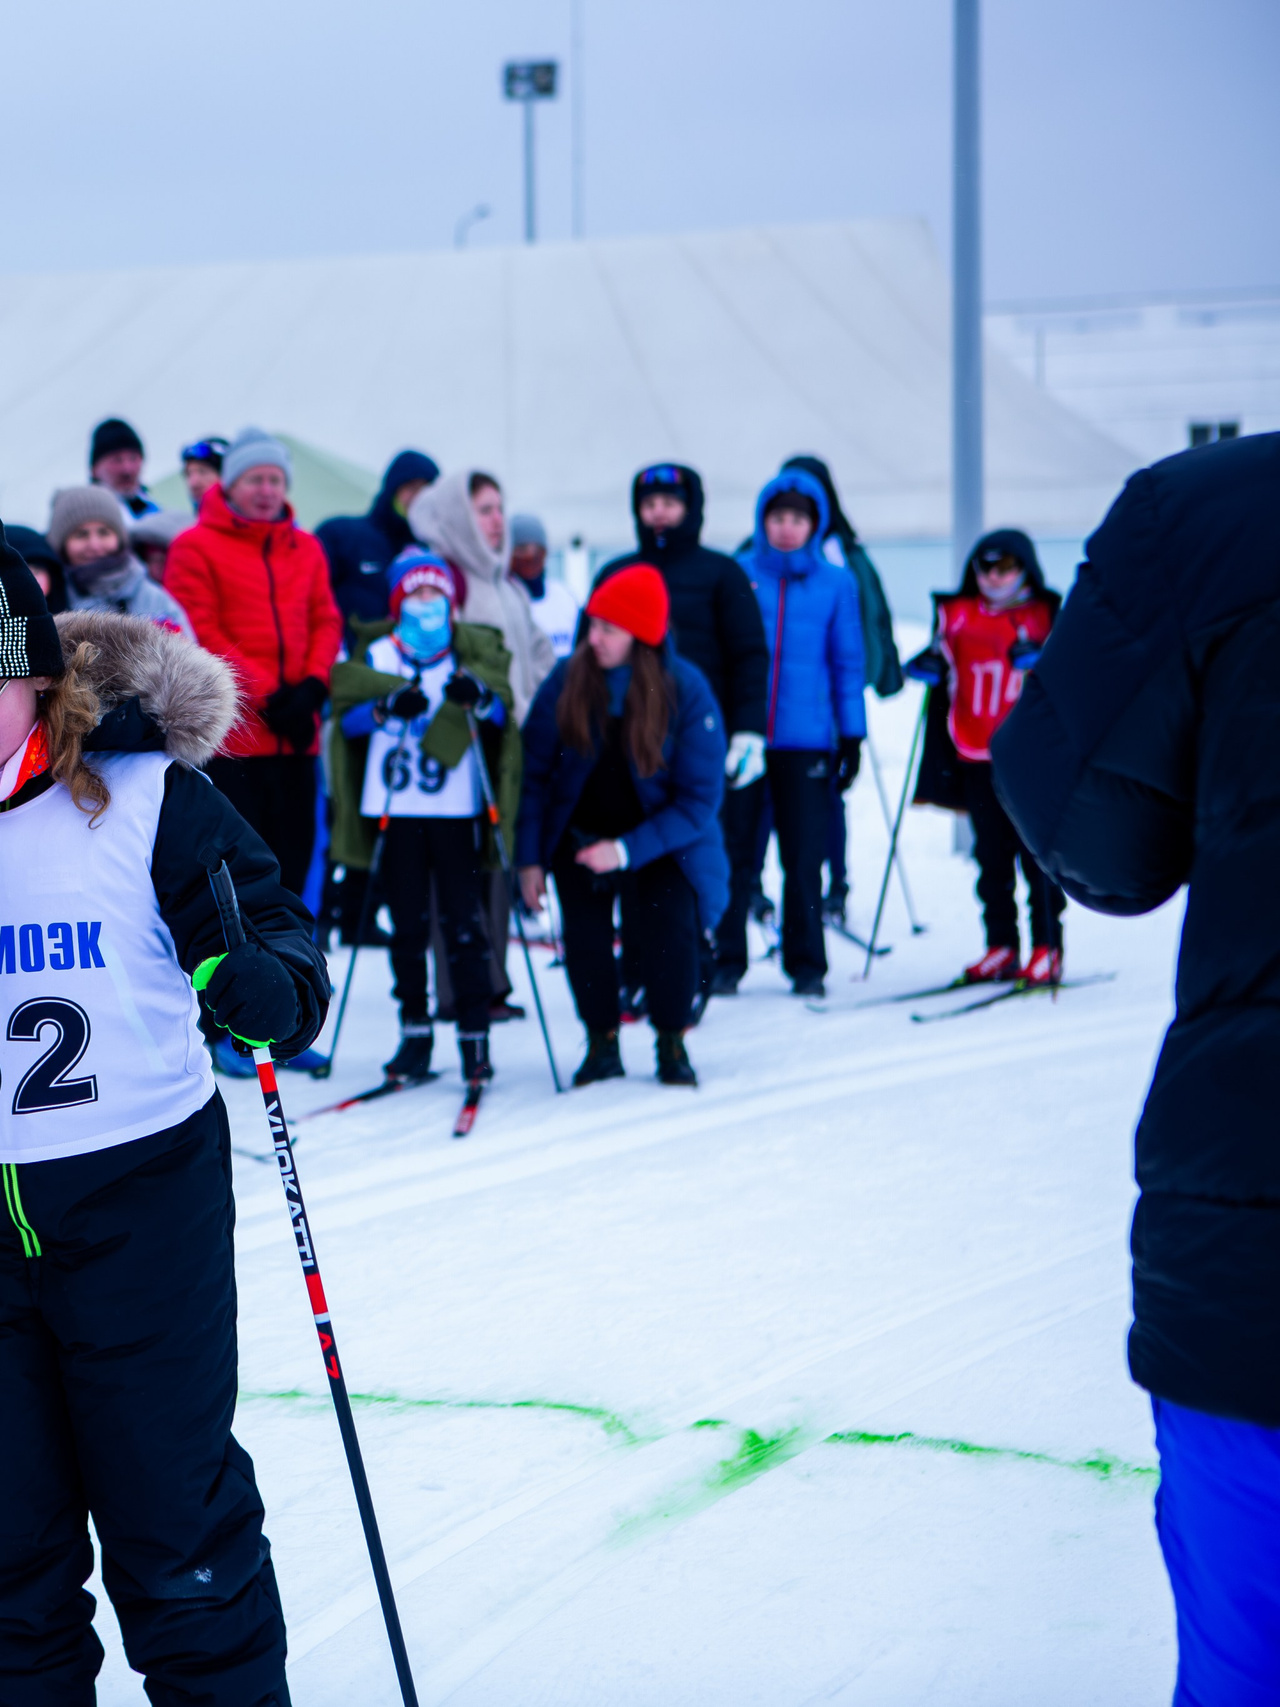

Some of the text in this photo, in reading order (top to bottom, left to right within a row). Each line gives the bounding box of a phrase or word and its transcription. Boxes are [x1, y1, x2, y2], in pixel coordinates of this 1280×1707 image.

[381, 748, 448, 793] 69
[266, 1099, 340, 1380] VUOKATTI A7
